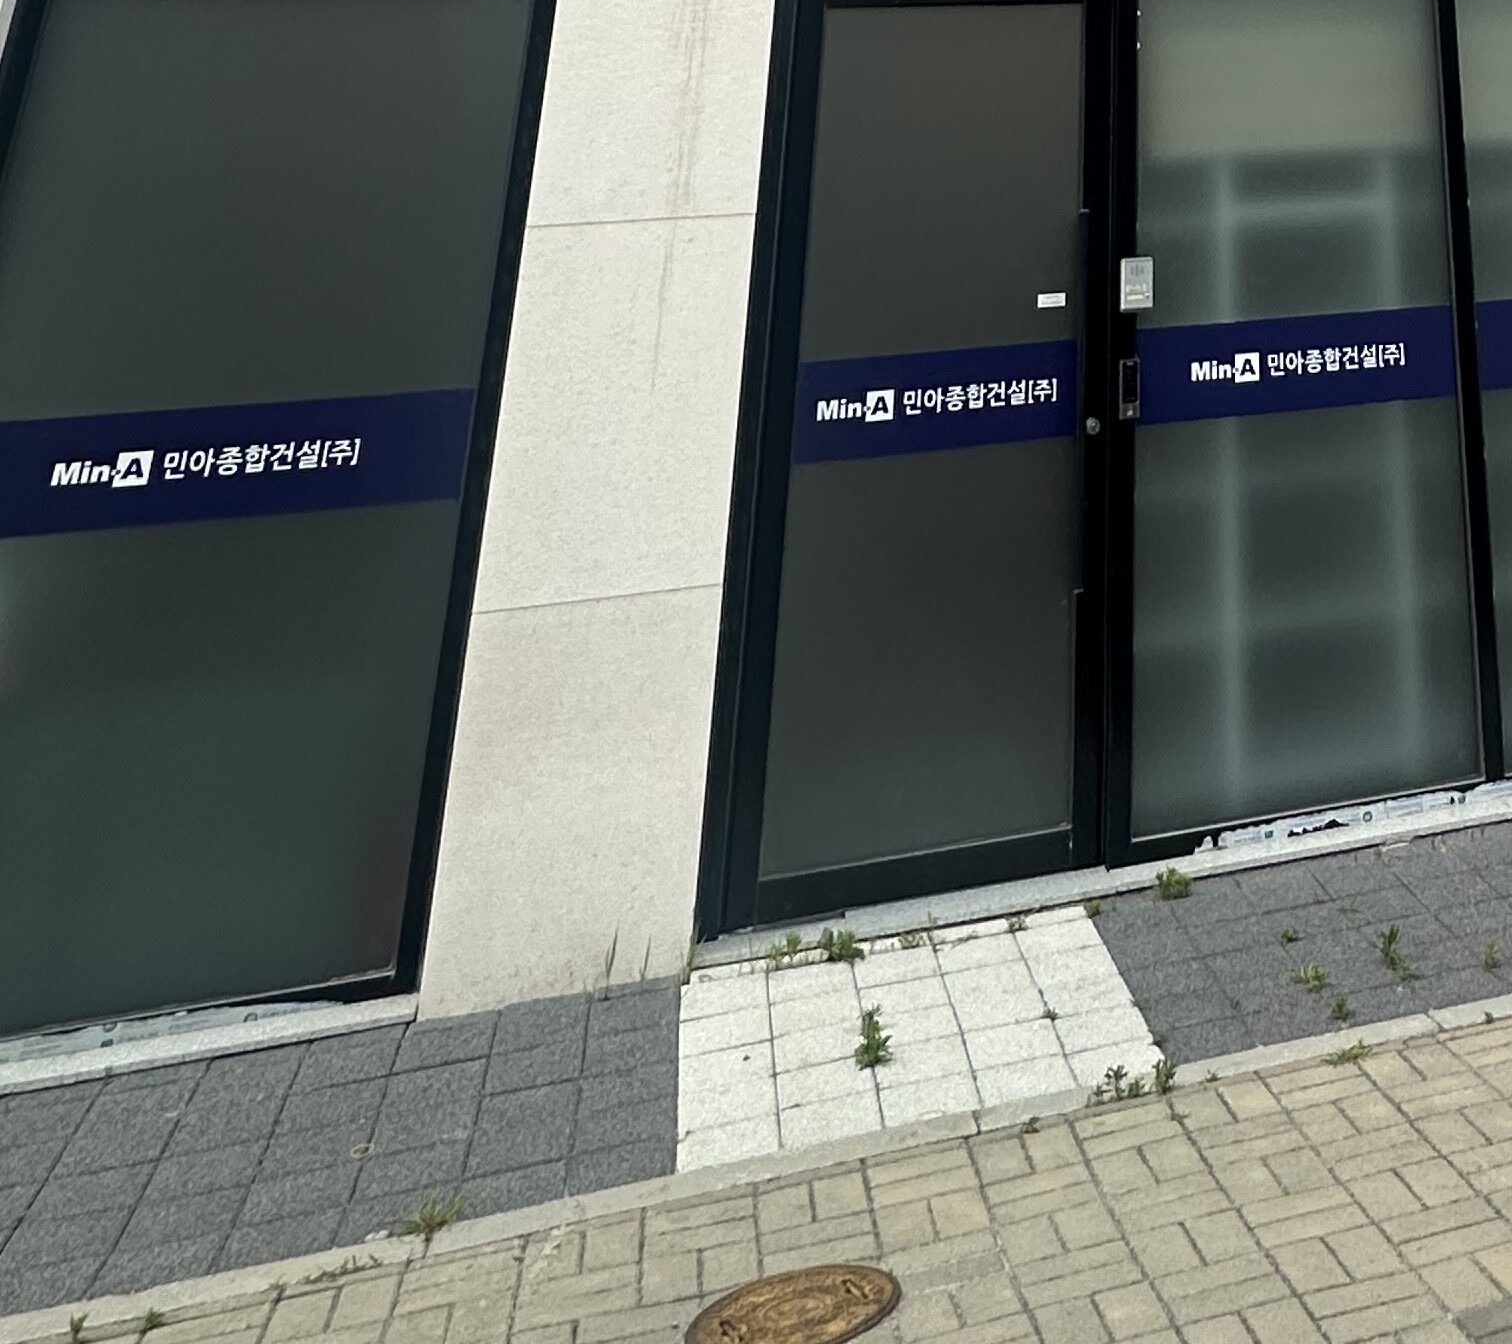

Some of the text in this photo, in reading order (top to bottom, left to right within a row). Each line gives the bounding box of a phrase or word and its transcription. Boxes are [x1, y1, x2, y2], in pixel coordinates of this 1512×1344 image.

[1267, 342, 1406, 377] 민아종합건설[주]
[902, 377, 1058, 416] 민아종합건설[주]
[163, 438, 362, 480] 민아종합건설[주]
